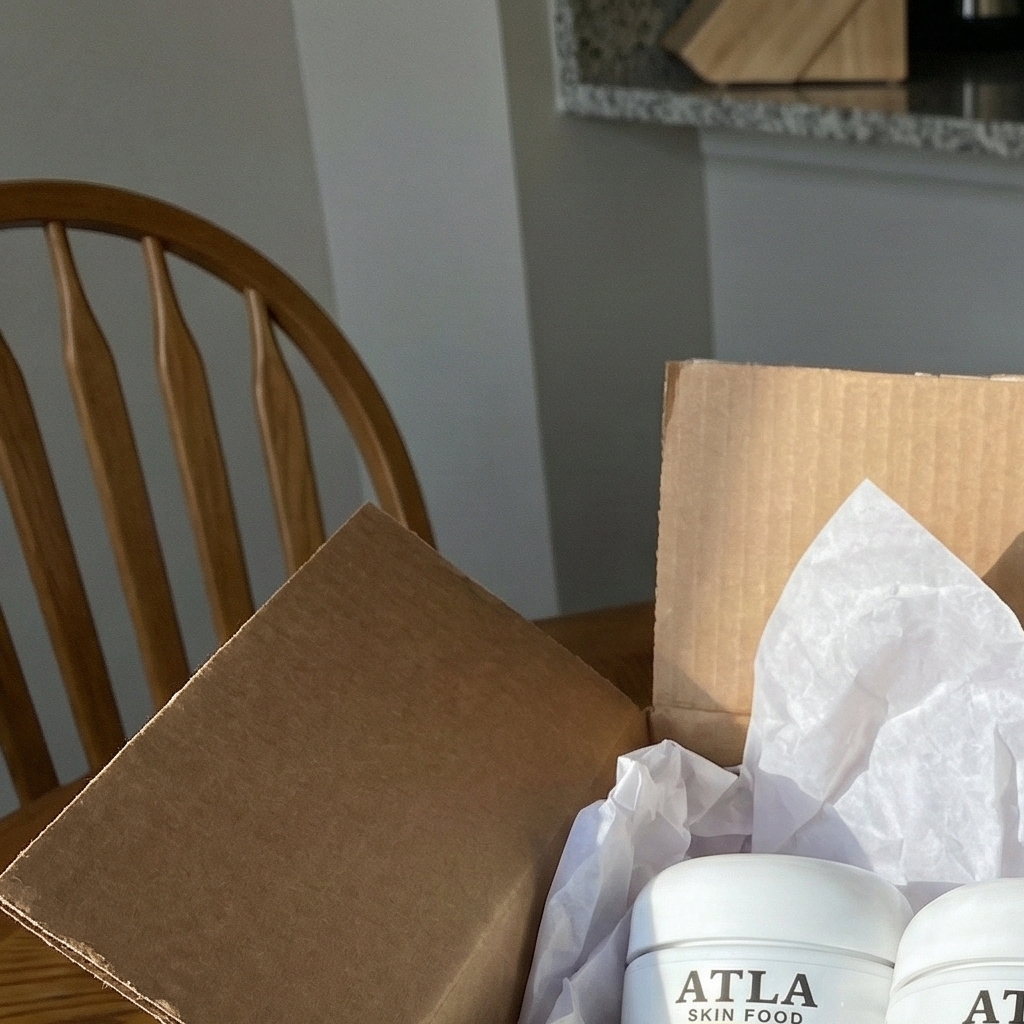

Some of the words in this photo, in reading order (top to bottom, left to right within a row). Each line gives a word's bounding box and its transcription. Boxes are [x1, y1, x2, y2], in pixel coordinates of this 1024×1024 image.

[675, 969, 818, 1008] ATLA
[688, 1008, 734, 1022] SKIN
[744, 1009, 803, 1024] FOOD
